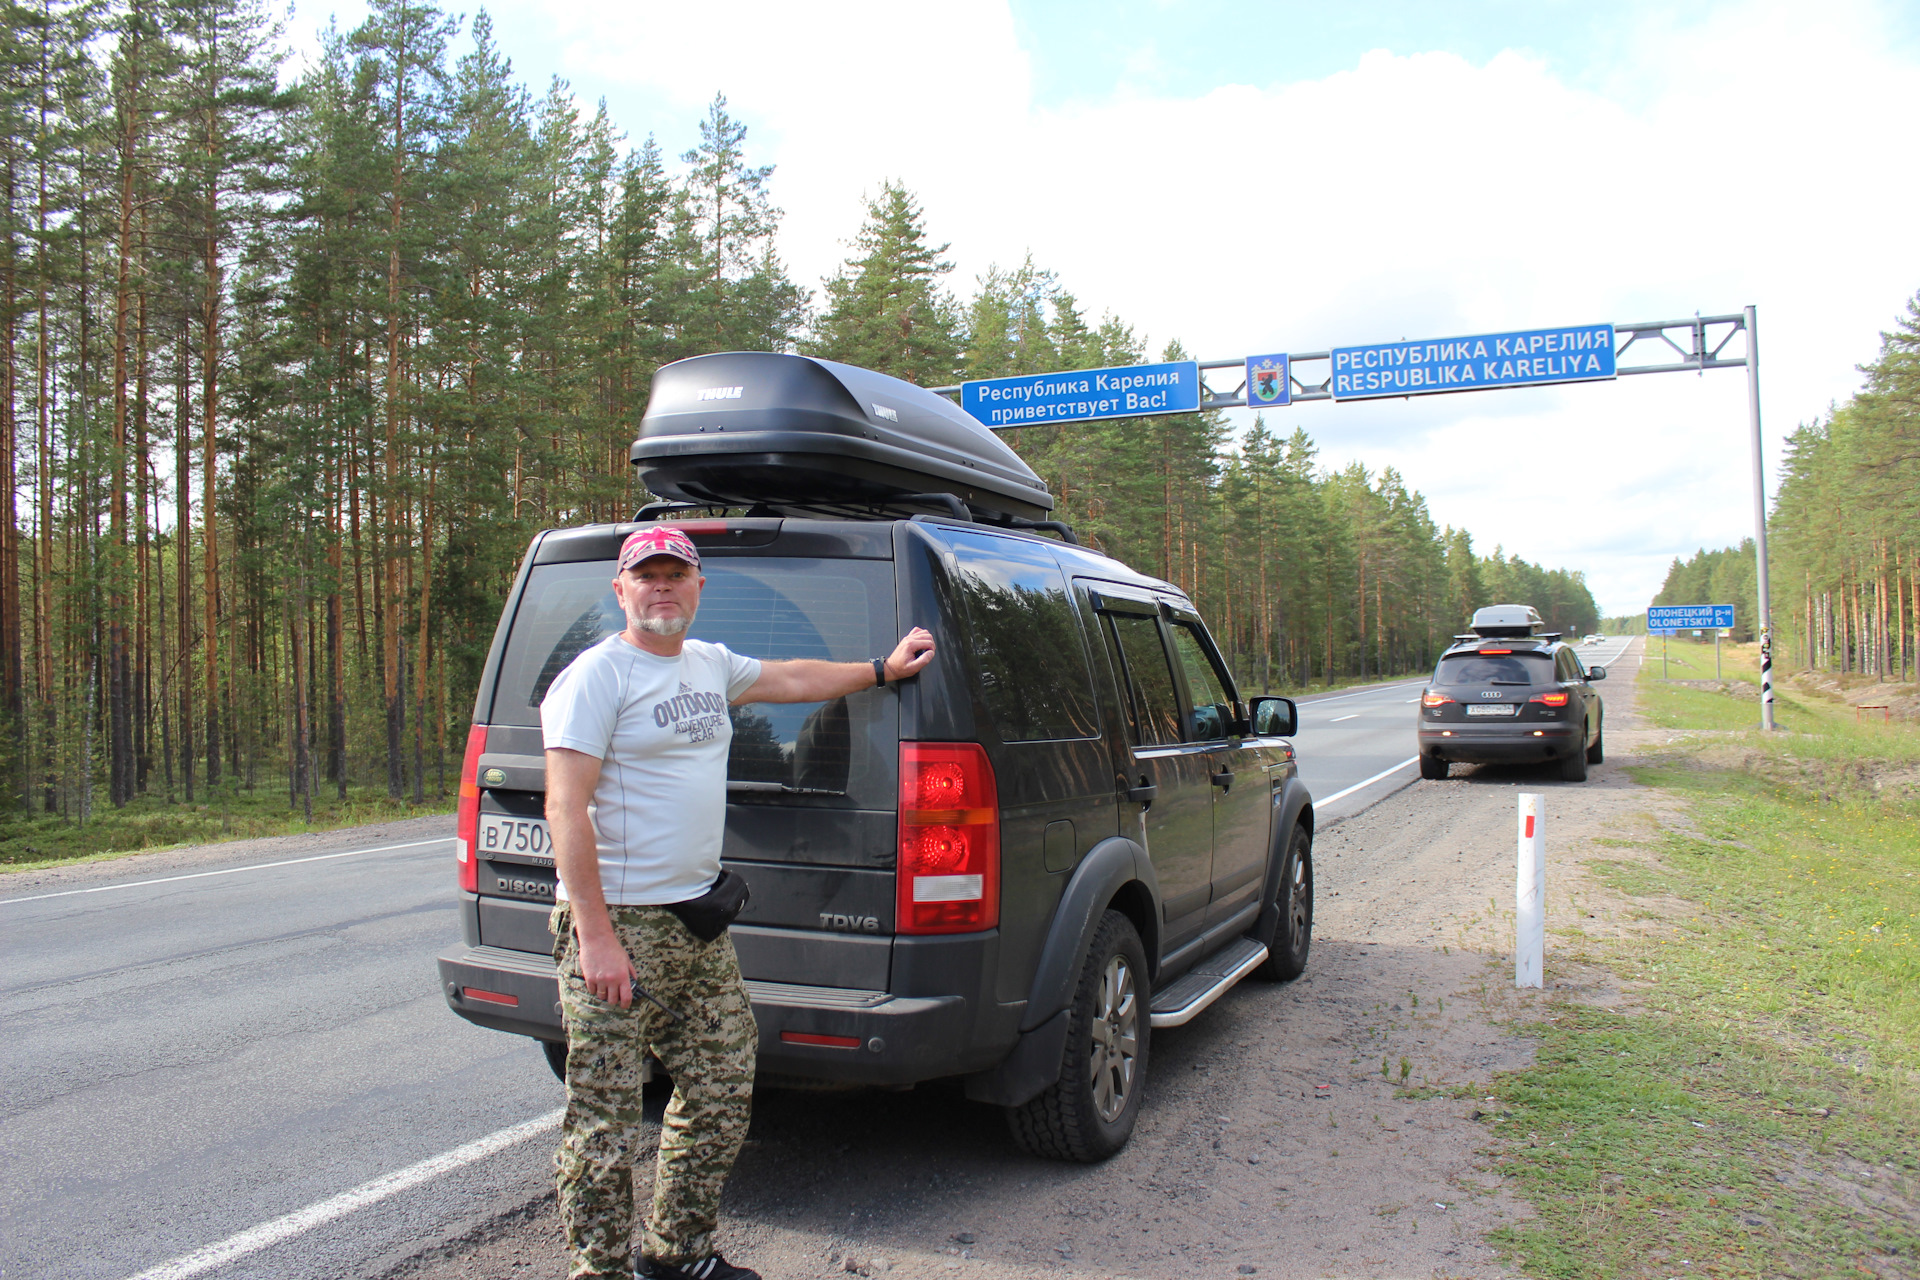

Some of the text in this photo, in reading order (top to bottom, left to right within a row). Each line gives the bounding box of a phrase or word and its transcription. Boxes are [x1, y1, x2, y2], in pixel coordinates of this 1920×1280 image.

[1336, 329, 1610, 371] РЕСПУБЛИКА КАРЕЛИЯ
[1337, 353, 1602, 392] RESPUBLIKA KARELIYA
[696, 386, 744, 401] THULE
[978, 371, 1180, 402] Республика Карелия
[991, 390, 1167, 424] приветствует Вас!
[1649, 606, 1713, 618] ОЛОНЕЦКИЙ
[1649, 617, 1713, 627] OLONETSKIY
[653, 691, 727, 728] OUTDOOR
[675, 714, 724, 734] ADVENTURE
[690, 727, 715, 743] GEAR
[532, 857, 556, 866] MAJO
[819, 912, 879, 930] TDV6
